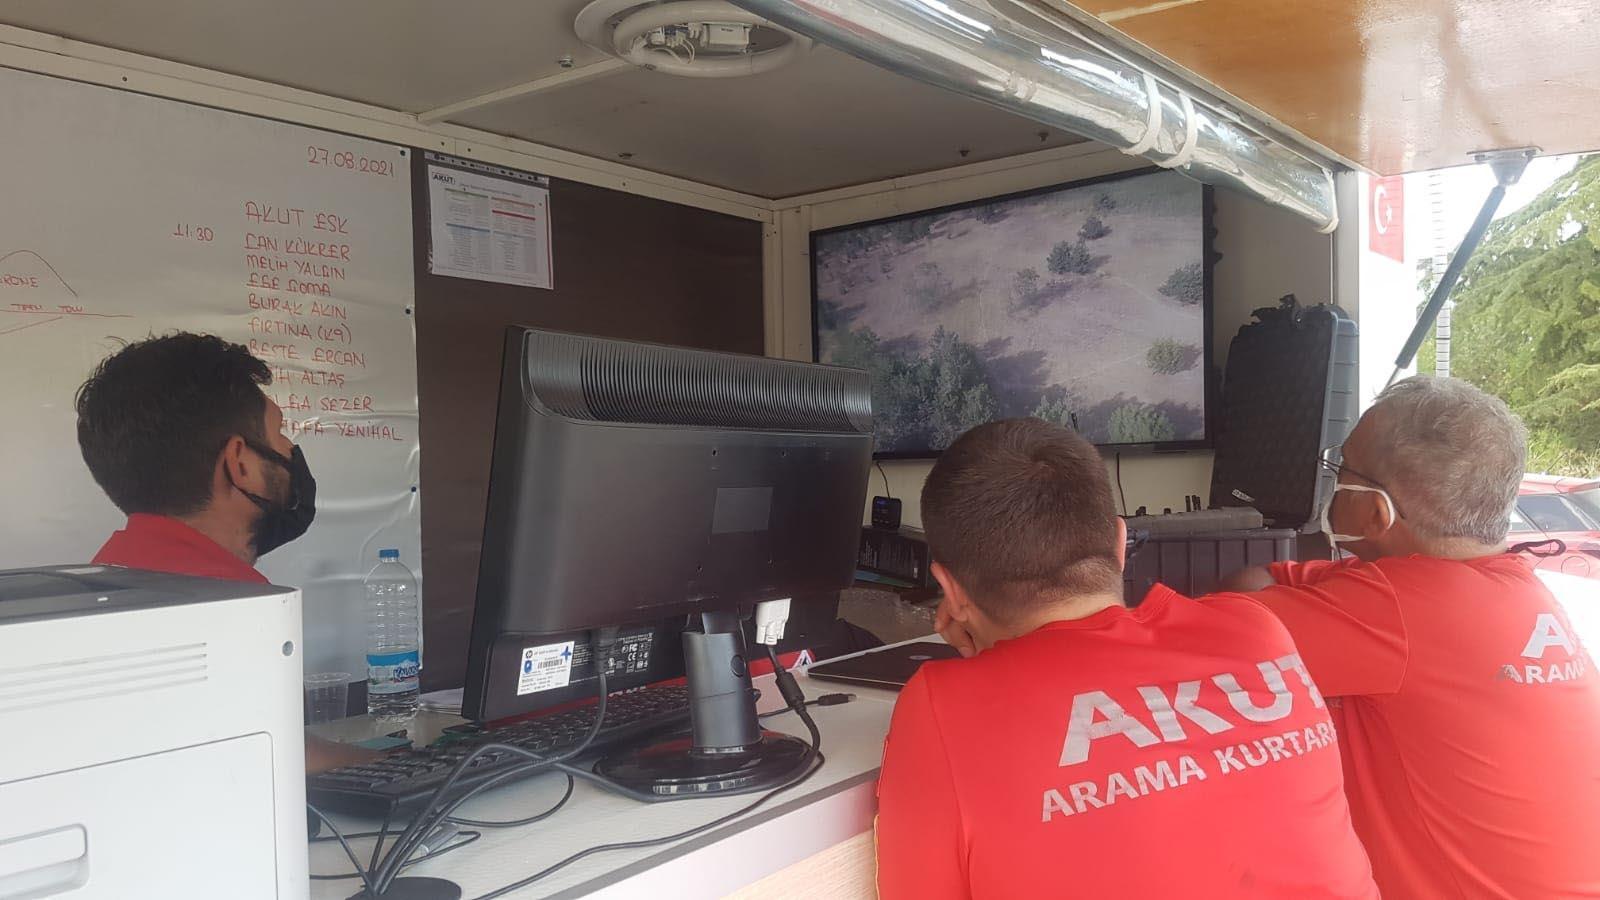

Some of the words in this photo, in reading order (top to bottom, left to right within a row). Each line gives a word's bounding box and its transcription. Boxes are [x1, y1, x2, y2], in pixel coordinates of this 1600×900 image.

[307, 146, 394, 177] 27.08.2021
[246, 201, 304, 227] AKUT
[313, 212, 348, 233] ESK
[244, 233, 278, 251] CAN
[0, 274, 38, 288] RONE
[248, 294, 302, 315] BURAK
[311, 302, 347, 320] AKIN
[312, 347, 366, 369] ERCAN
[320, 396, 374, 412] SEZER
[1496, 659, 1586, 684] ARAM
[1059, 653, 1323, 767] AKUT
[1041, 755, 1207, 822] ARAMA
